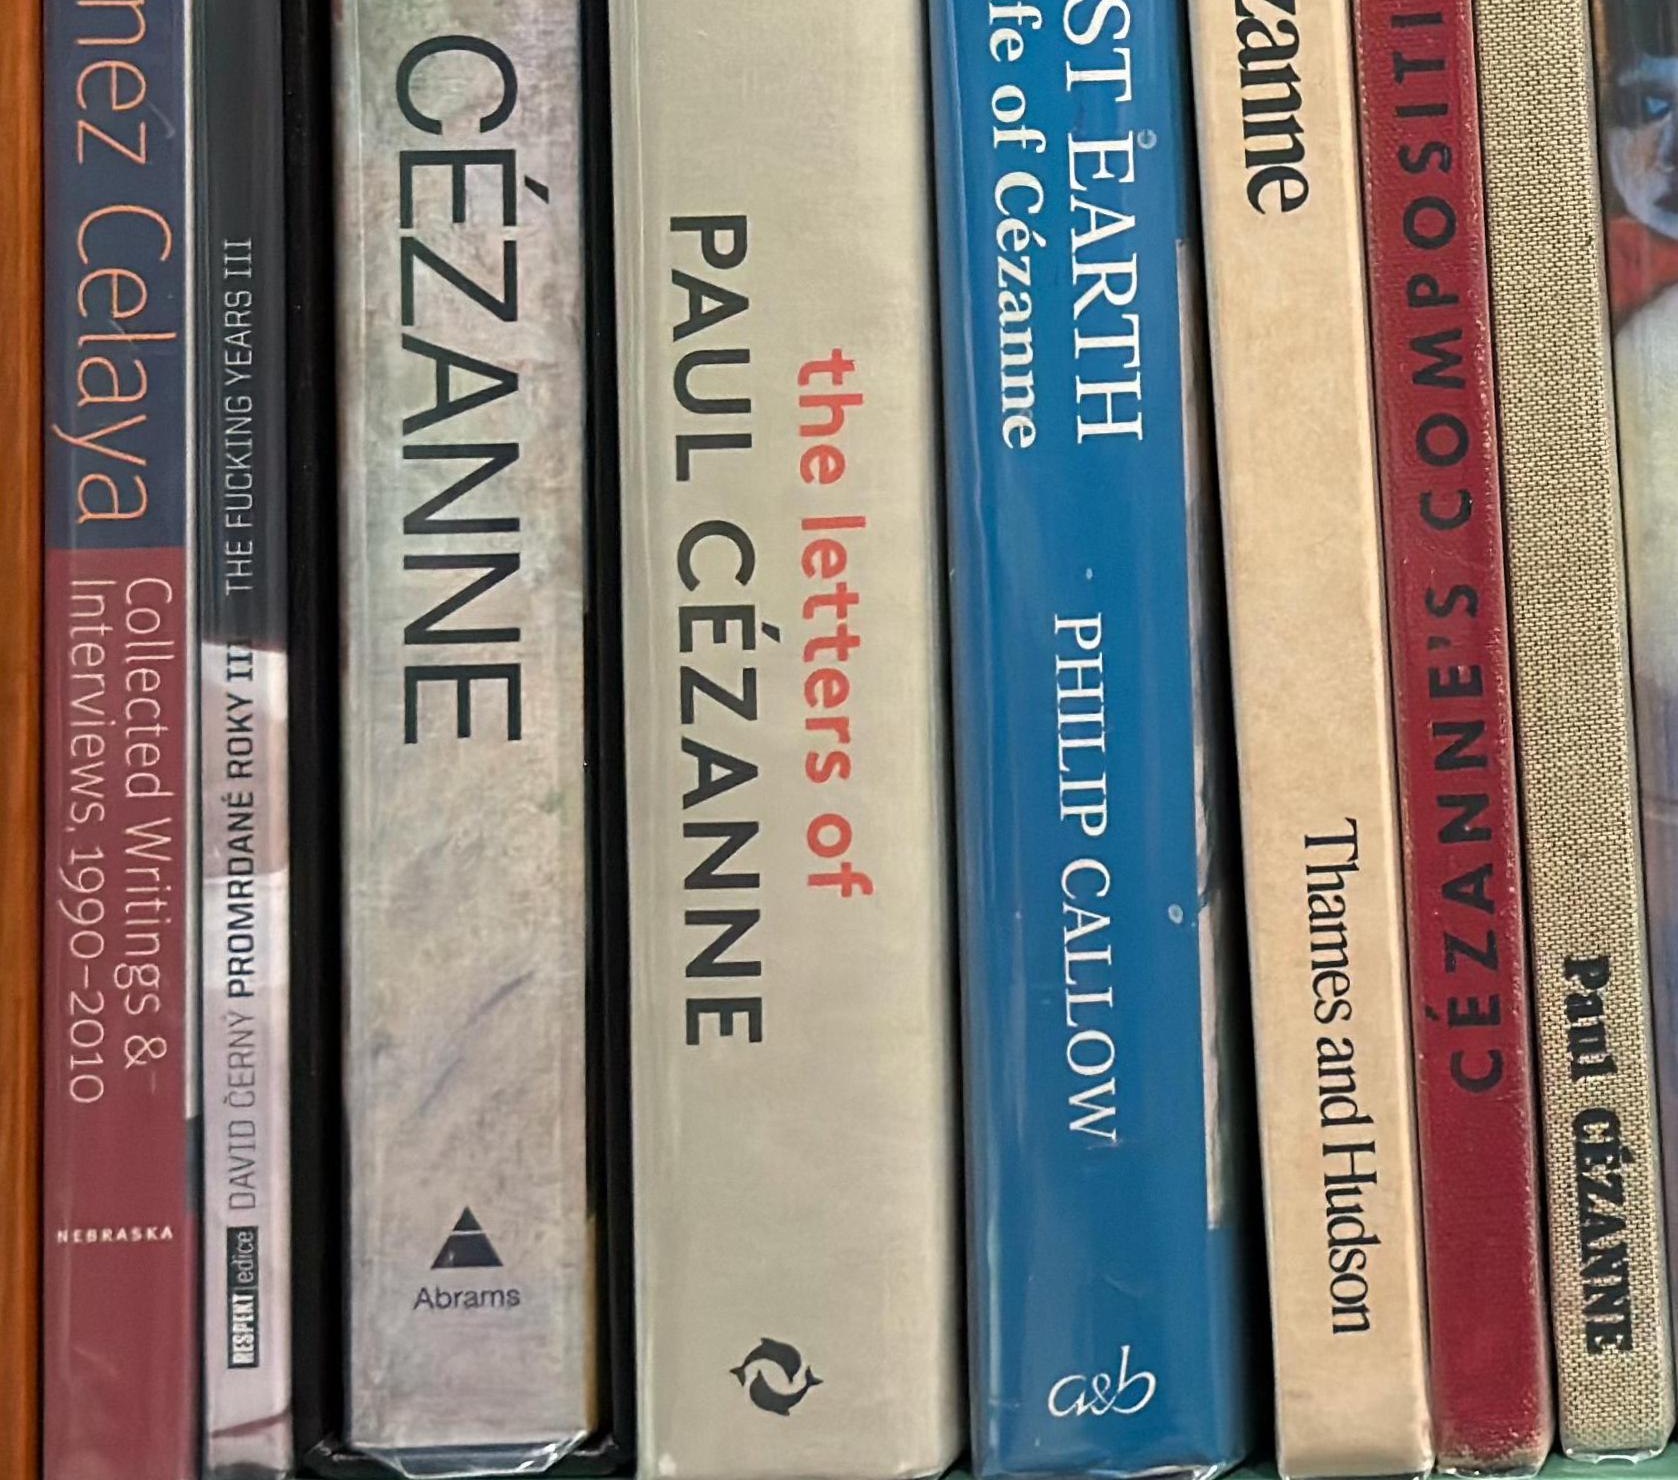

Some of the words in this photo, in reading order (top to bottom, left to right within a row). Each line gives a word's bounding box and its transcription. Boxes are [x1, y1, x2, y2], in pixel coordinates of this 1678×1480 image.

[991, 85, 1048, 154] of
[52, 205, 177, 527] Celaya
[224, 292, 254, 382] YEARS
[396, 33, 550, 745] CÉZANNE
[669, 213, 753, 483] PAUL
[993, 170, 1046, 450] Cézanne
[1067, 129, 1144, 447] EARTH
[224, 397, 254, 536] FUCKING
[797, 347, 864, 485] the
[61, 579, 117, 838] Interviews,
[123, 576, 174, 803] Collected
[226, 694, 256, 786] ROKY
[798, 515, 867, 785] letters
[1053, 612, 1110, 838] PHILIP
[676, 517, 781, 1045] CÉZANNE
[805, 811, 875, 899] of
[1422, 582, 1505, 1095] CÉZANNE'S
[111, 816, 174, 1017] Writings
[224, 791, 258, 998] PROMRDANÉ
[1303, 816, 1360, 1025] Thames
[123, 1033, 169, 1071] &
[1060, 856, 1117, 1144] CALLOW
[1315, 1035, 1369, 1129] and
[55, 1224, 175, 1245] NEBRASKA
[228, 1118, 256, 1211] DAVID
[1320, 1137, 1382, 1336] Hudson
[1572, 1106, 1636, 1358] CÉZANNE
[414, 1284, 522, 1310] Abrams
